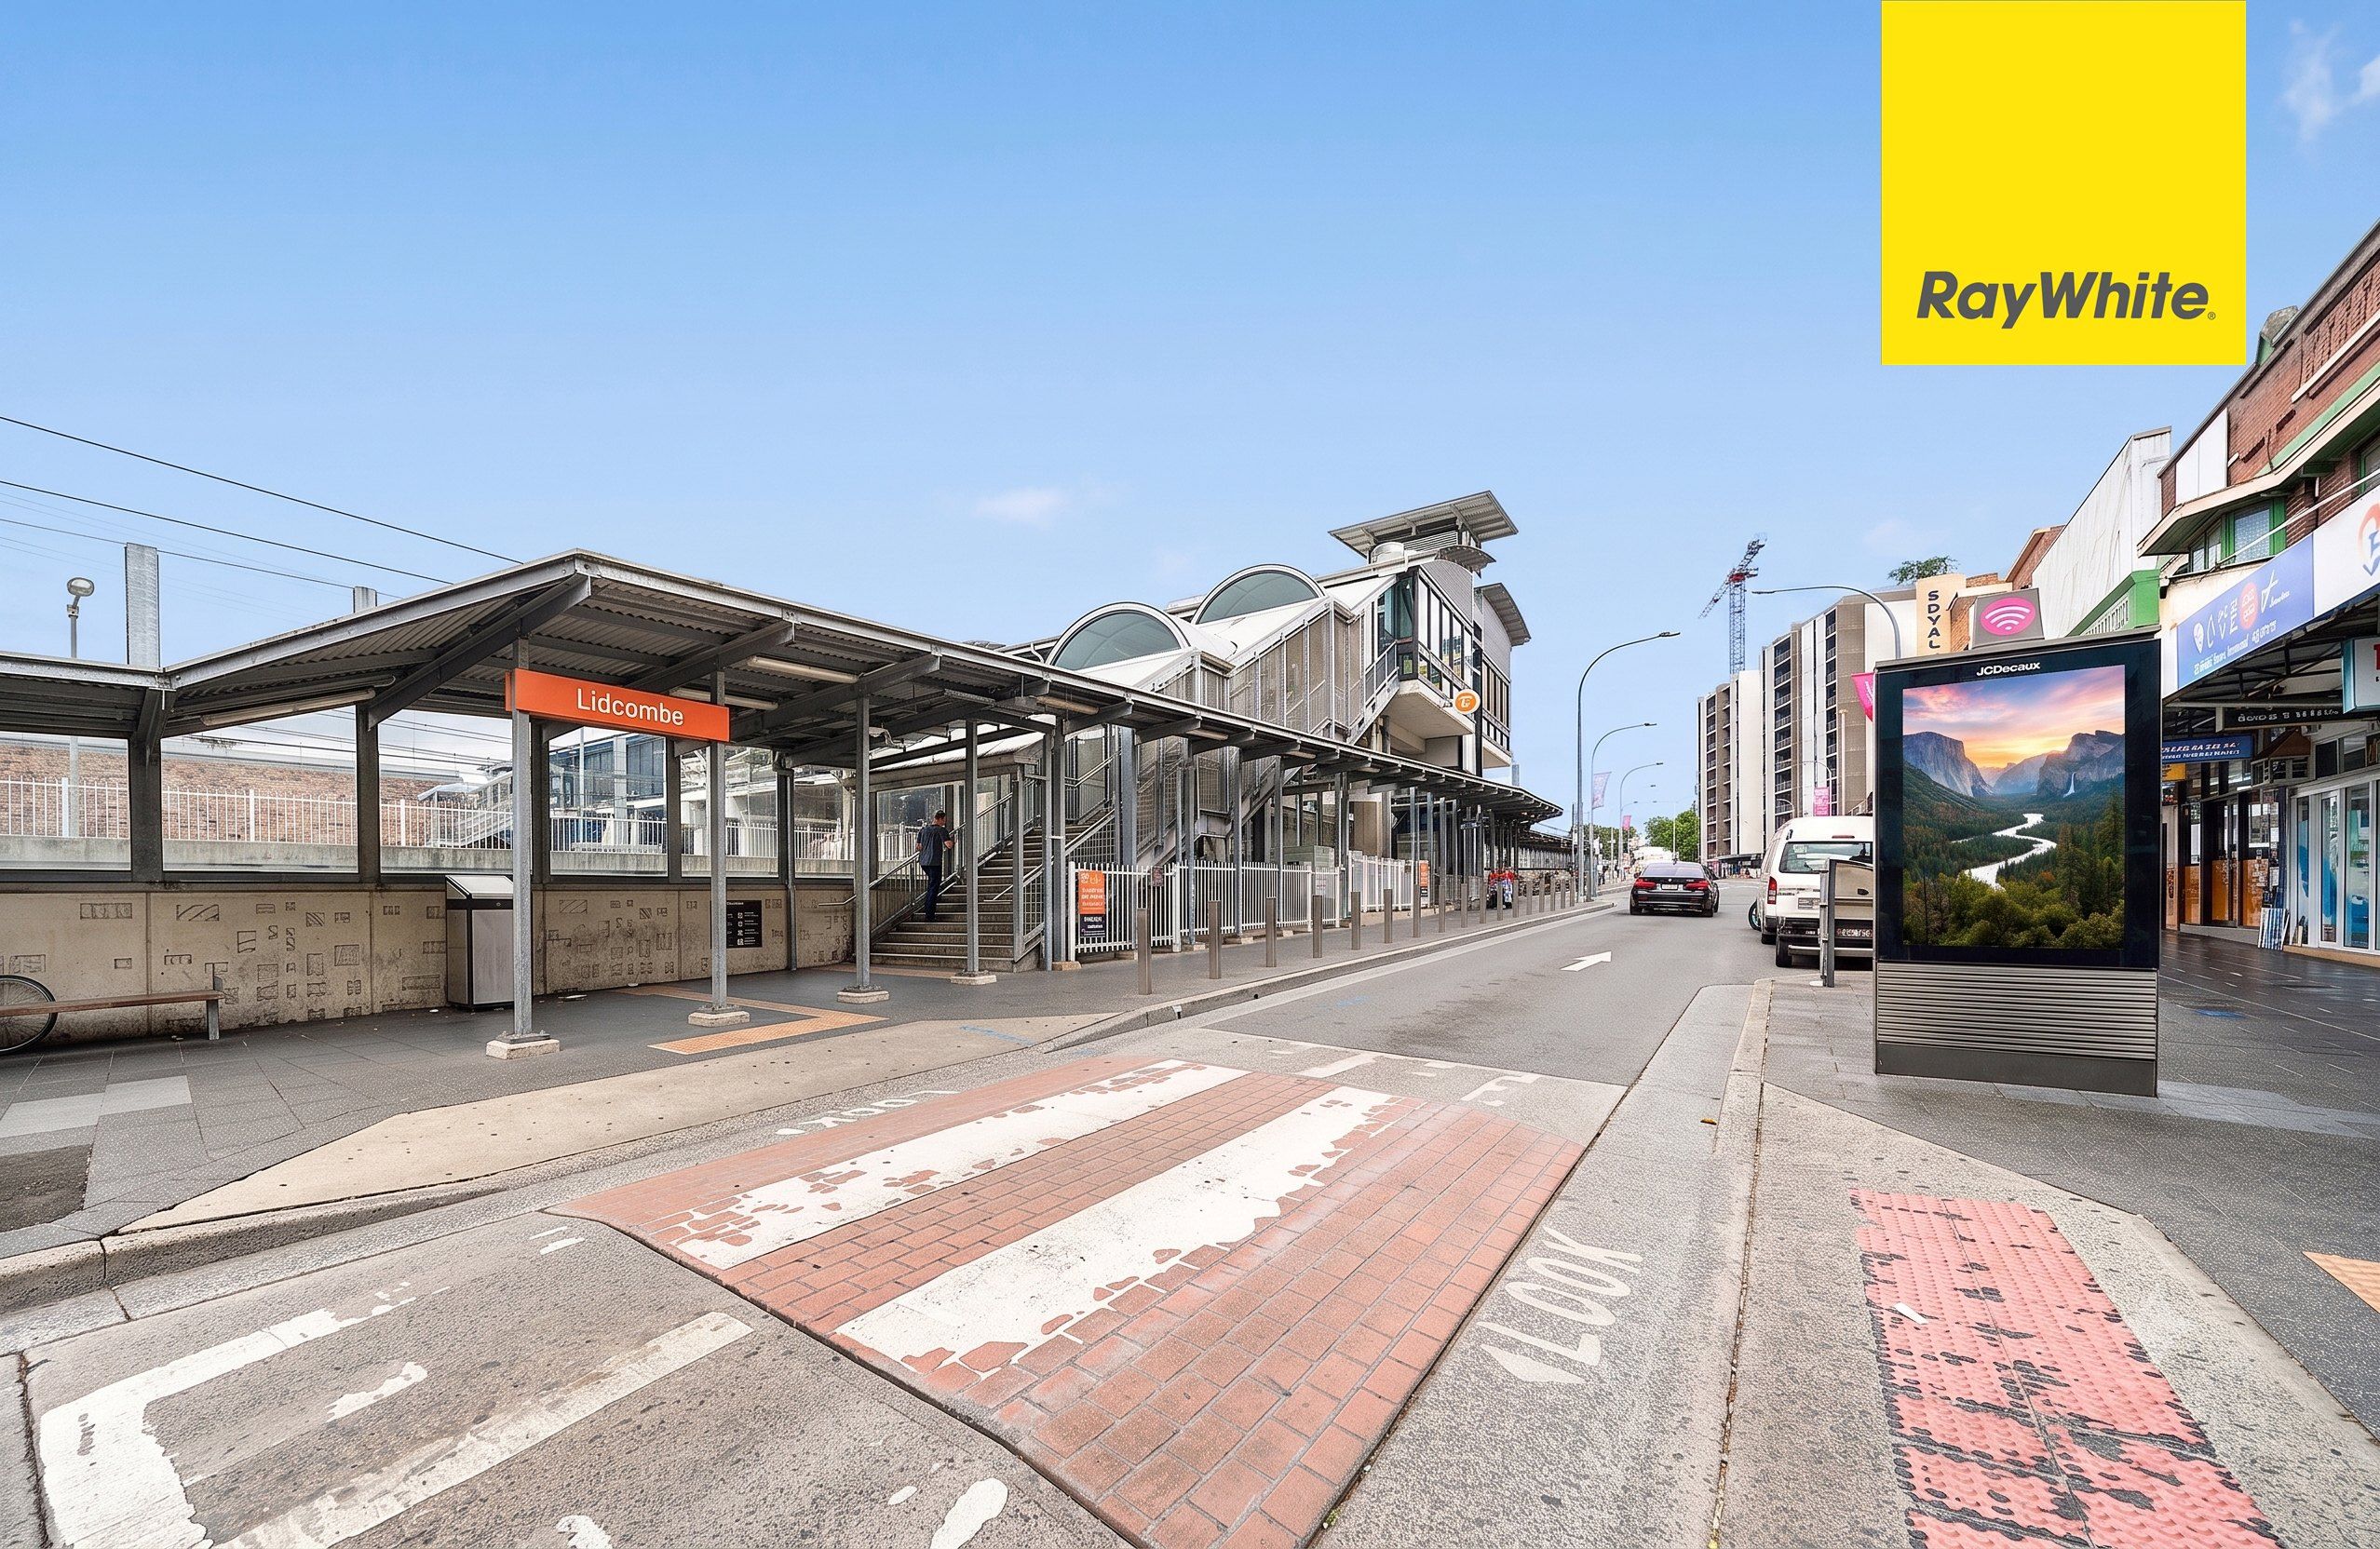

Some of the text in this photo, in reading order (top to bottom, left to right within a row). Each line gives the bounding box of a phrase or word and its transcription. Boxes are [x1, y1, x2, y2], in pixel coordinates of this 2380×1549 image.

[1976, 662, 2041, 677] JCDecaux
[576, 688, 684, 726] Lidcombe
[1476, 1226, 1643, 1367] LOOK
